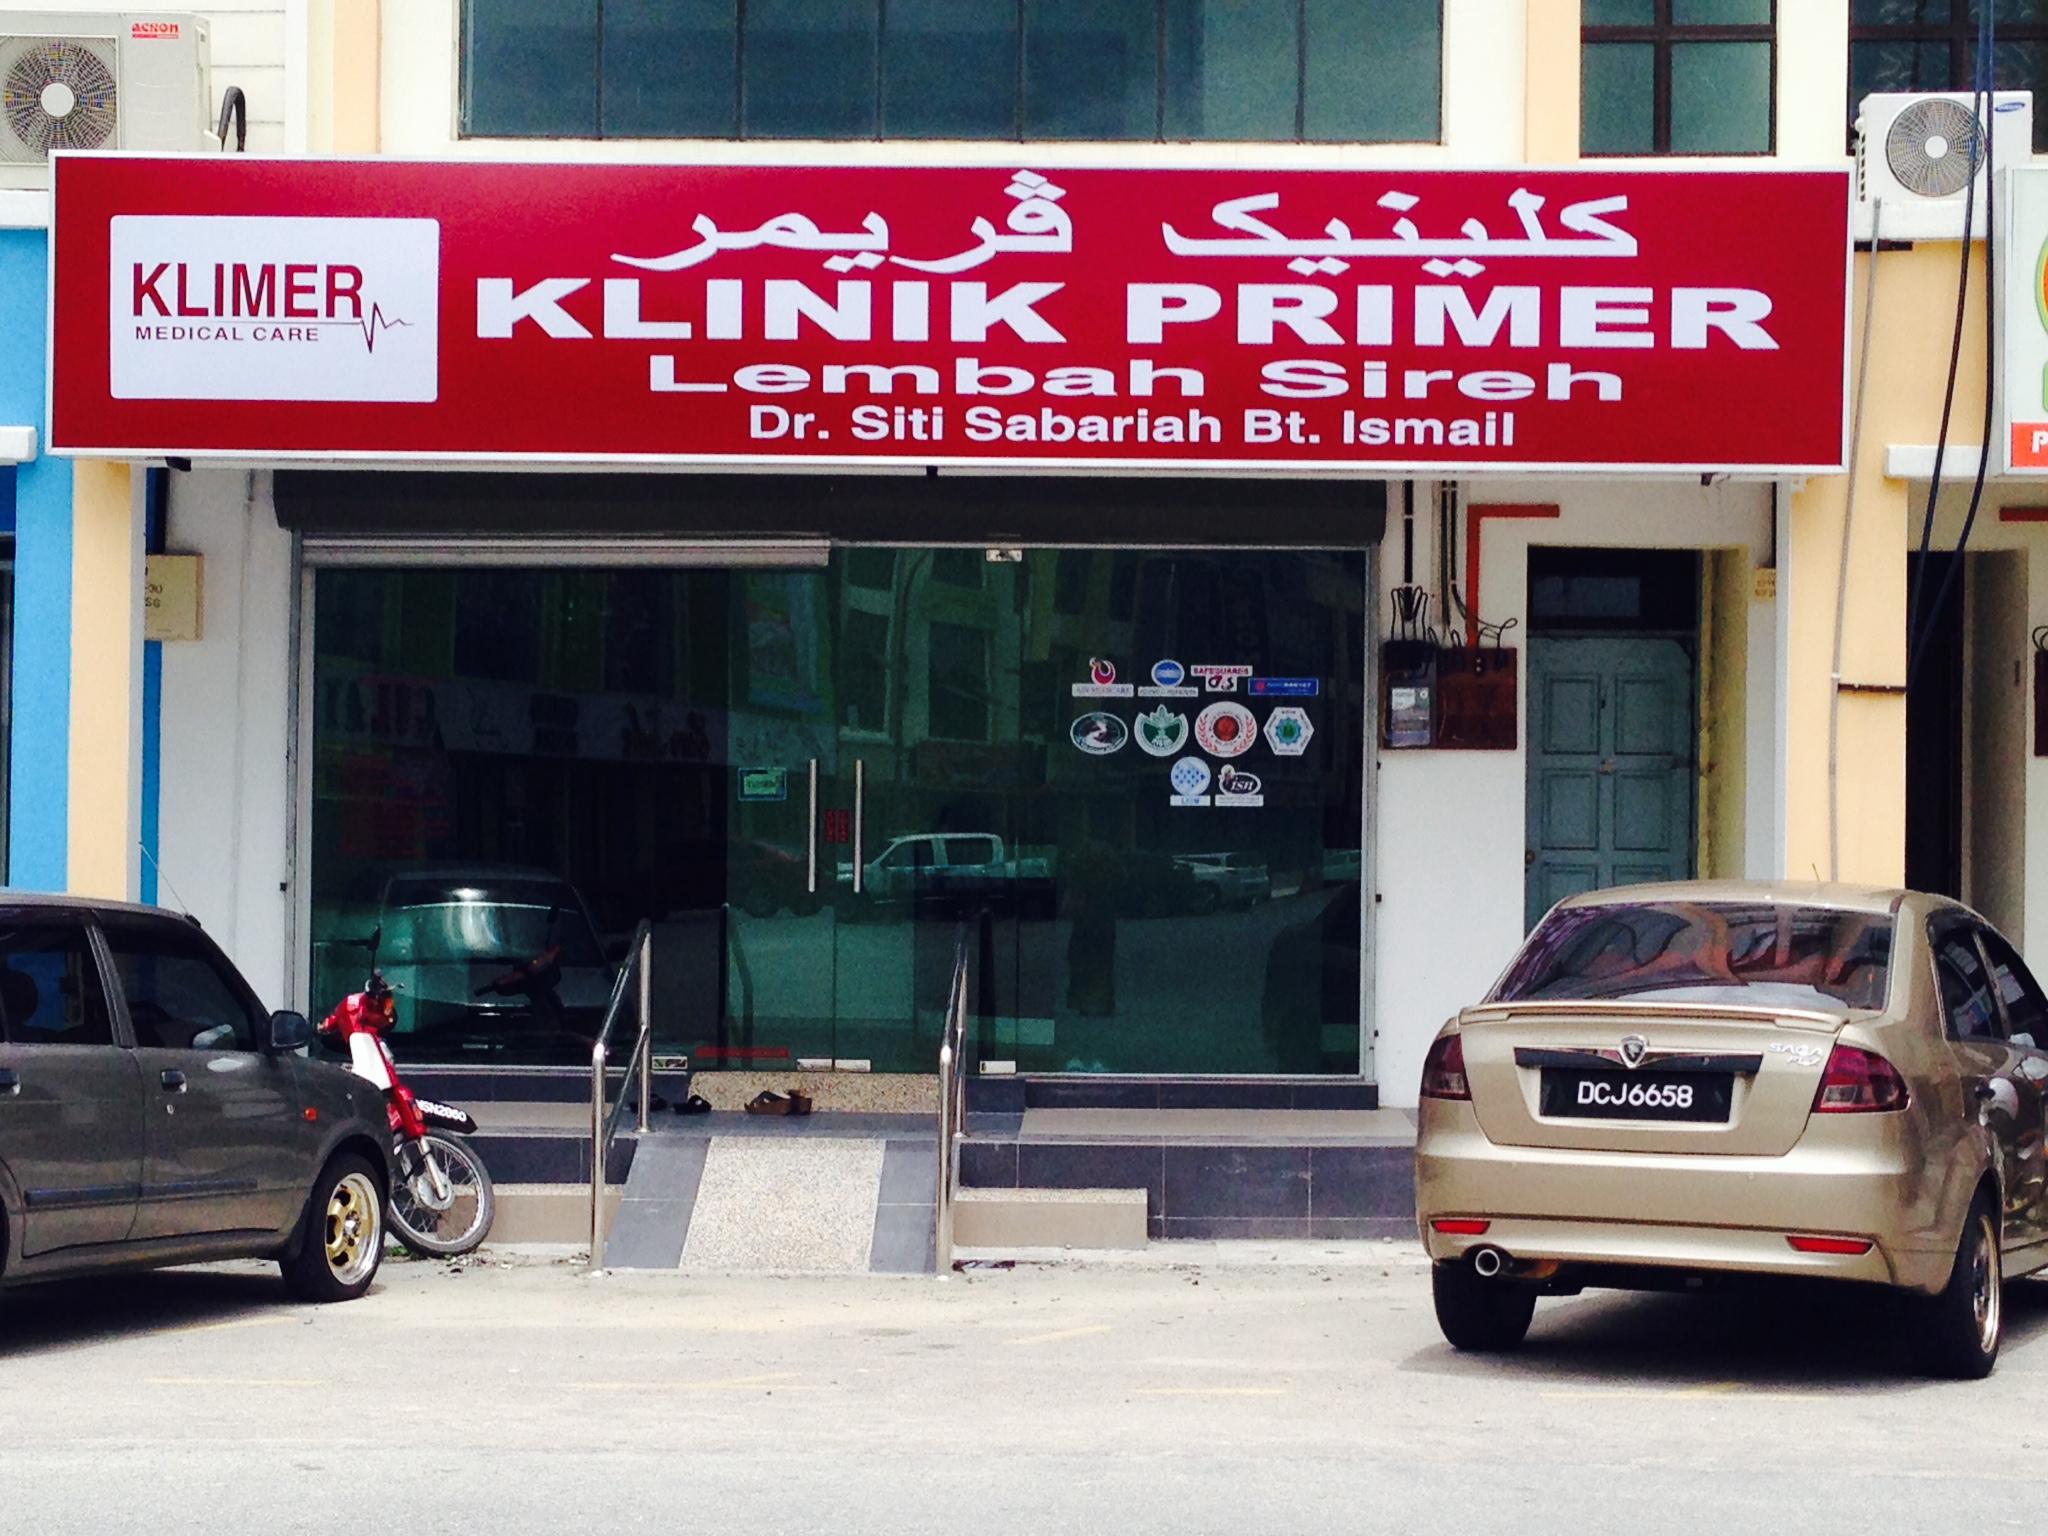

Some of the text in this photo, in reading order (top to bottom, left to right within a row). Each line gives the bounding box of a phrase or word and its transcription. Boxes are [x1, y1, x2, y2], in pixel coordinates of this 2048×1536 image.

[133, 262, 363, 318] KLIMER
[135, 326, 319, 341] MEDICAL CARE
[476, 277, 1780, 350] KLINIK PRIMER
[650, 356, 1622, 402] Lembah Sireh
[750, 406, 1514, 446] Dr. Siti Sabariah Bt. Ismail
[1577, 1081, 1693, 1108] DCJ6658
